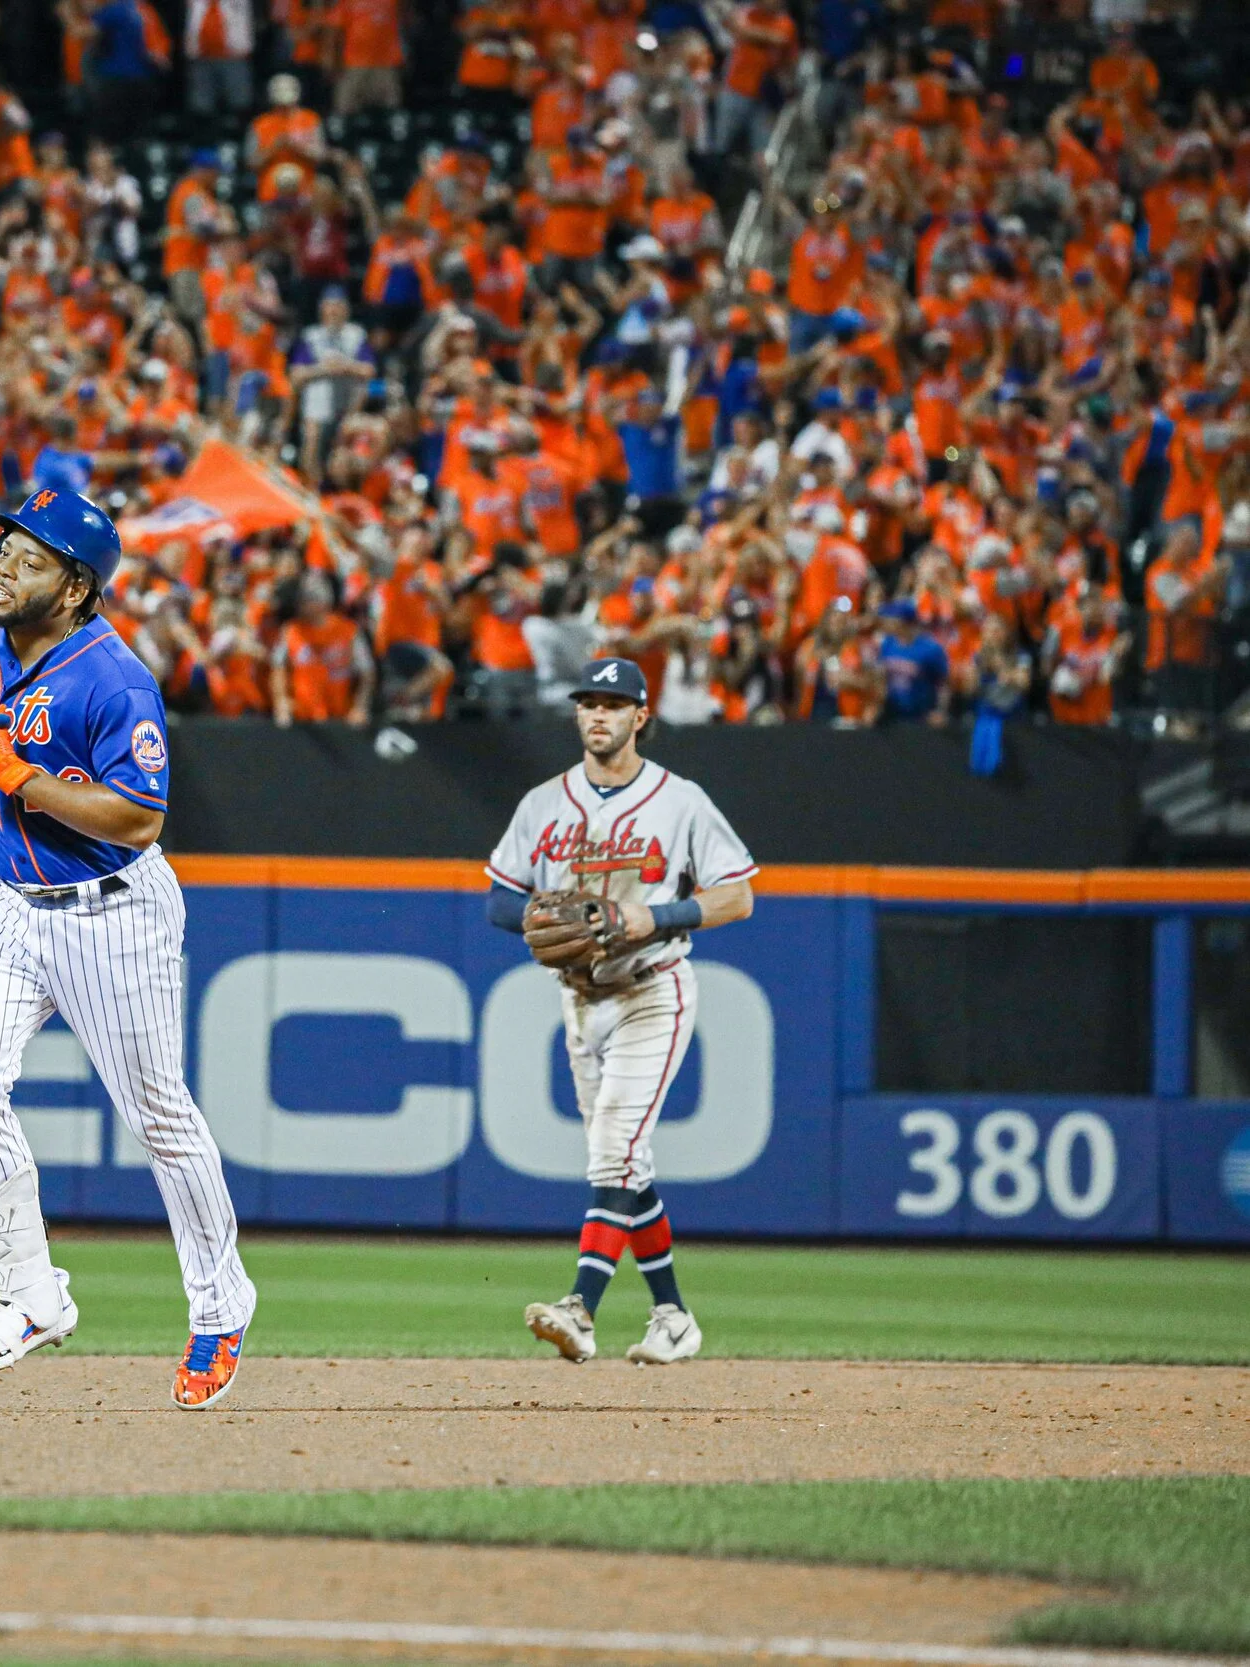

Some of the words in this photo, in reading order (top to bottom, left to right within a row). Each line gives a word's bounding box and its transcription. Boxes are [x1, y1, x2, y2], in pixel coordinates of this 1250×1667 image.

[592, 662, 618, 682] A
[530, 818, 645, 867] Atlanta
[896, 1109, 1118, 1220] 380
